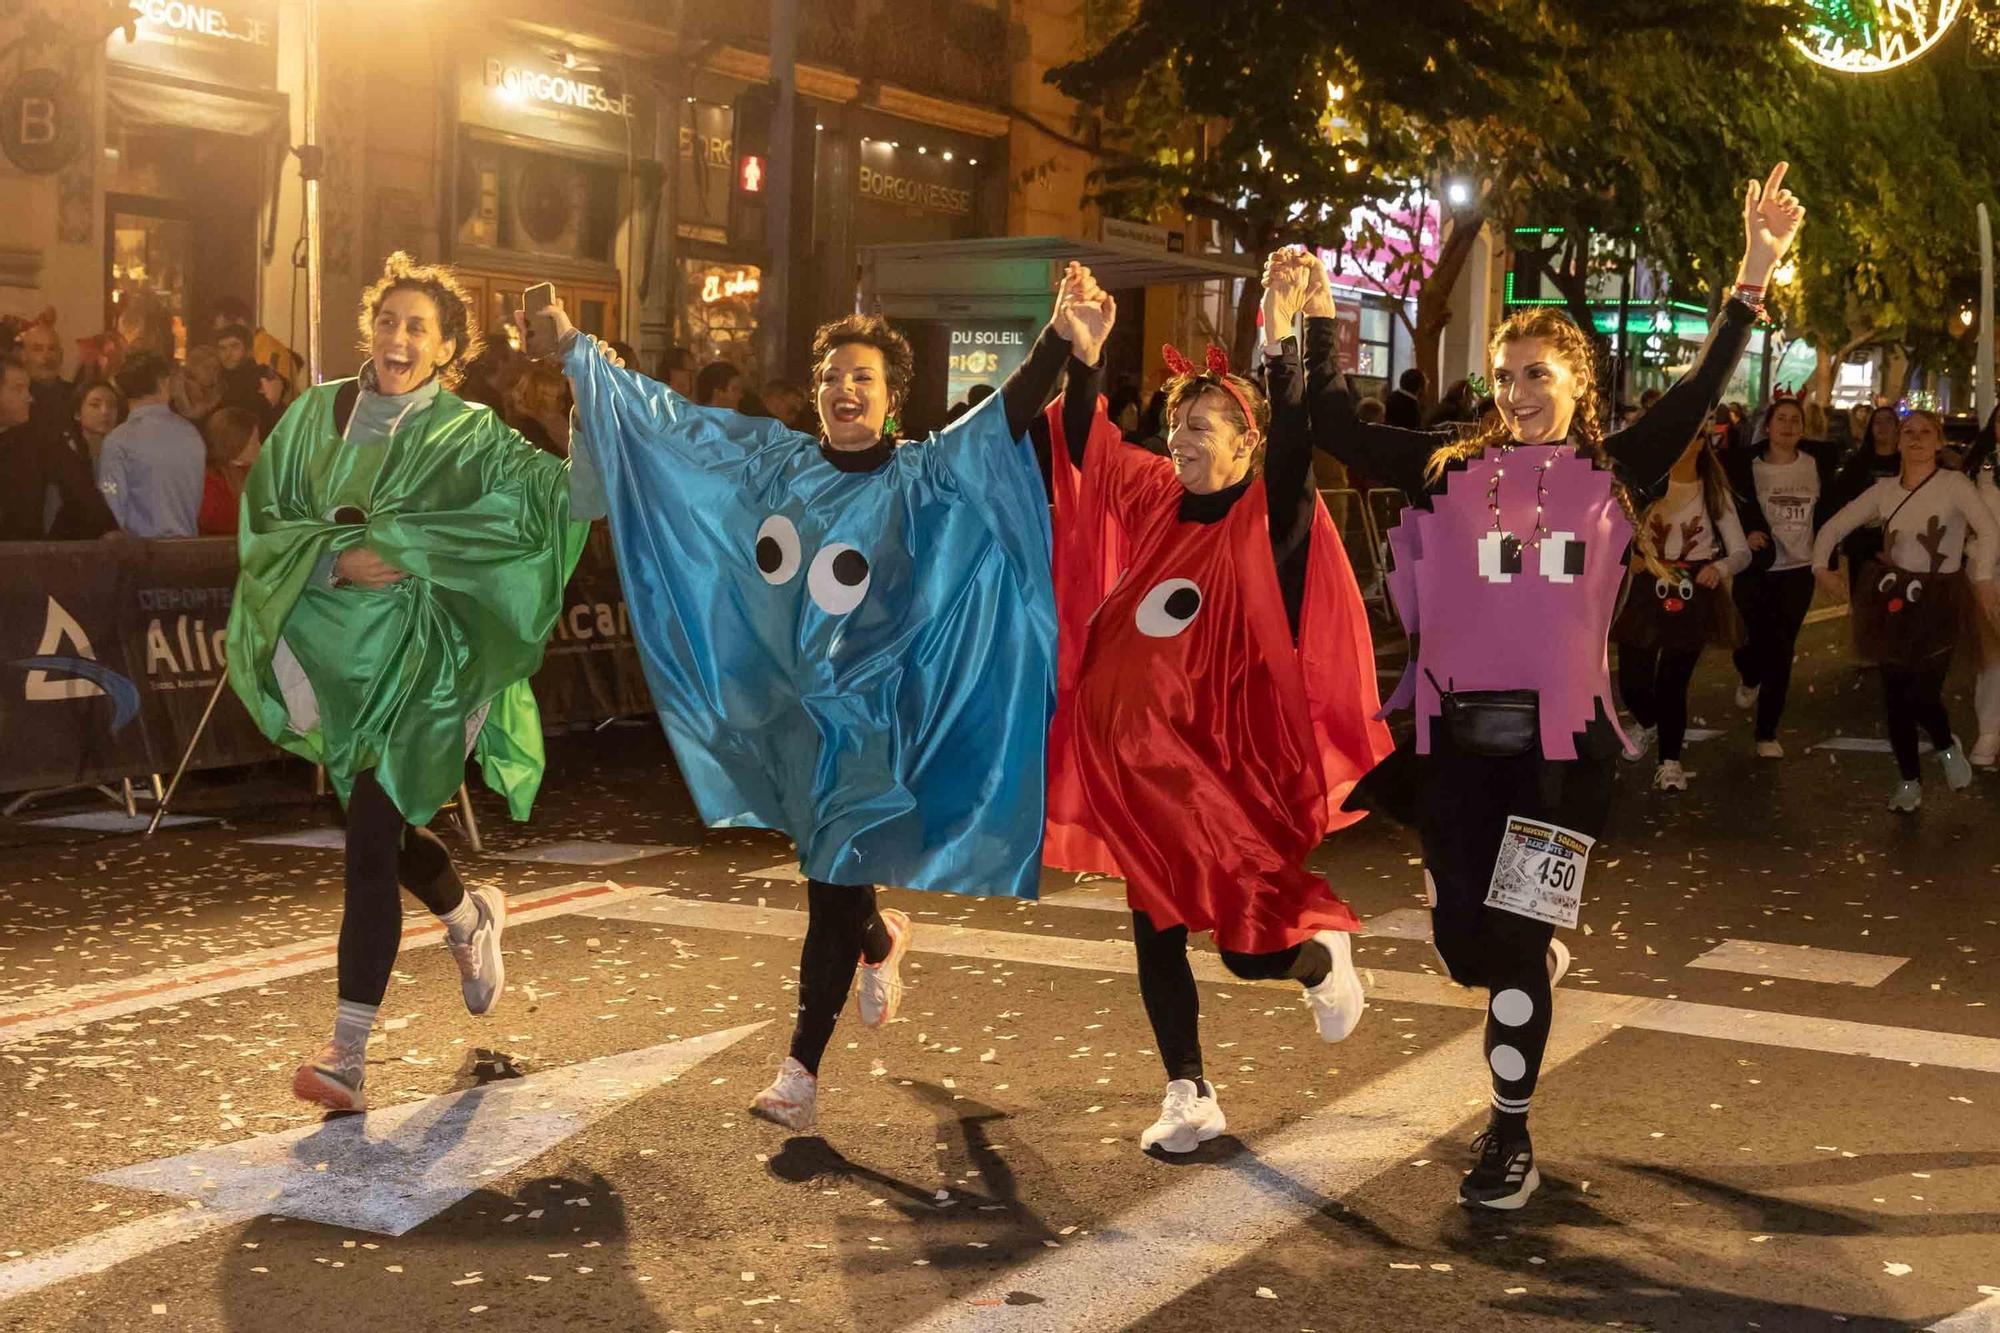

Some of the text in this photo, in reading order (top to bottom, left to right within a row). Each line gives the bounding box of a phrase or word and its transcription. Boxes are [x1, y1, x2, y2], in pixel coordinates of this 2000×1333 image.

[21, 98, 55, 144] B
[860, 166, 971, 212] BORGONESSE
[951, 331, 1023, 345] DU SOLEIL
[1785, 507, 1805, 519] 311
[1538, 856, 1576, 892] 450
